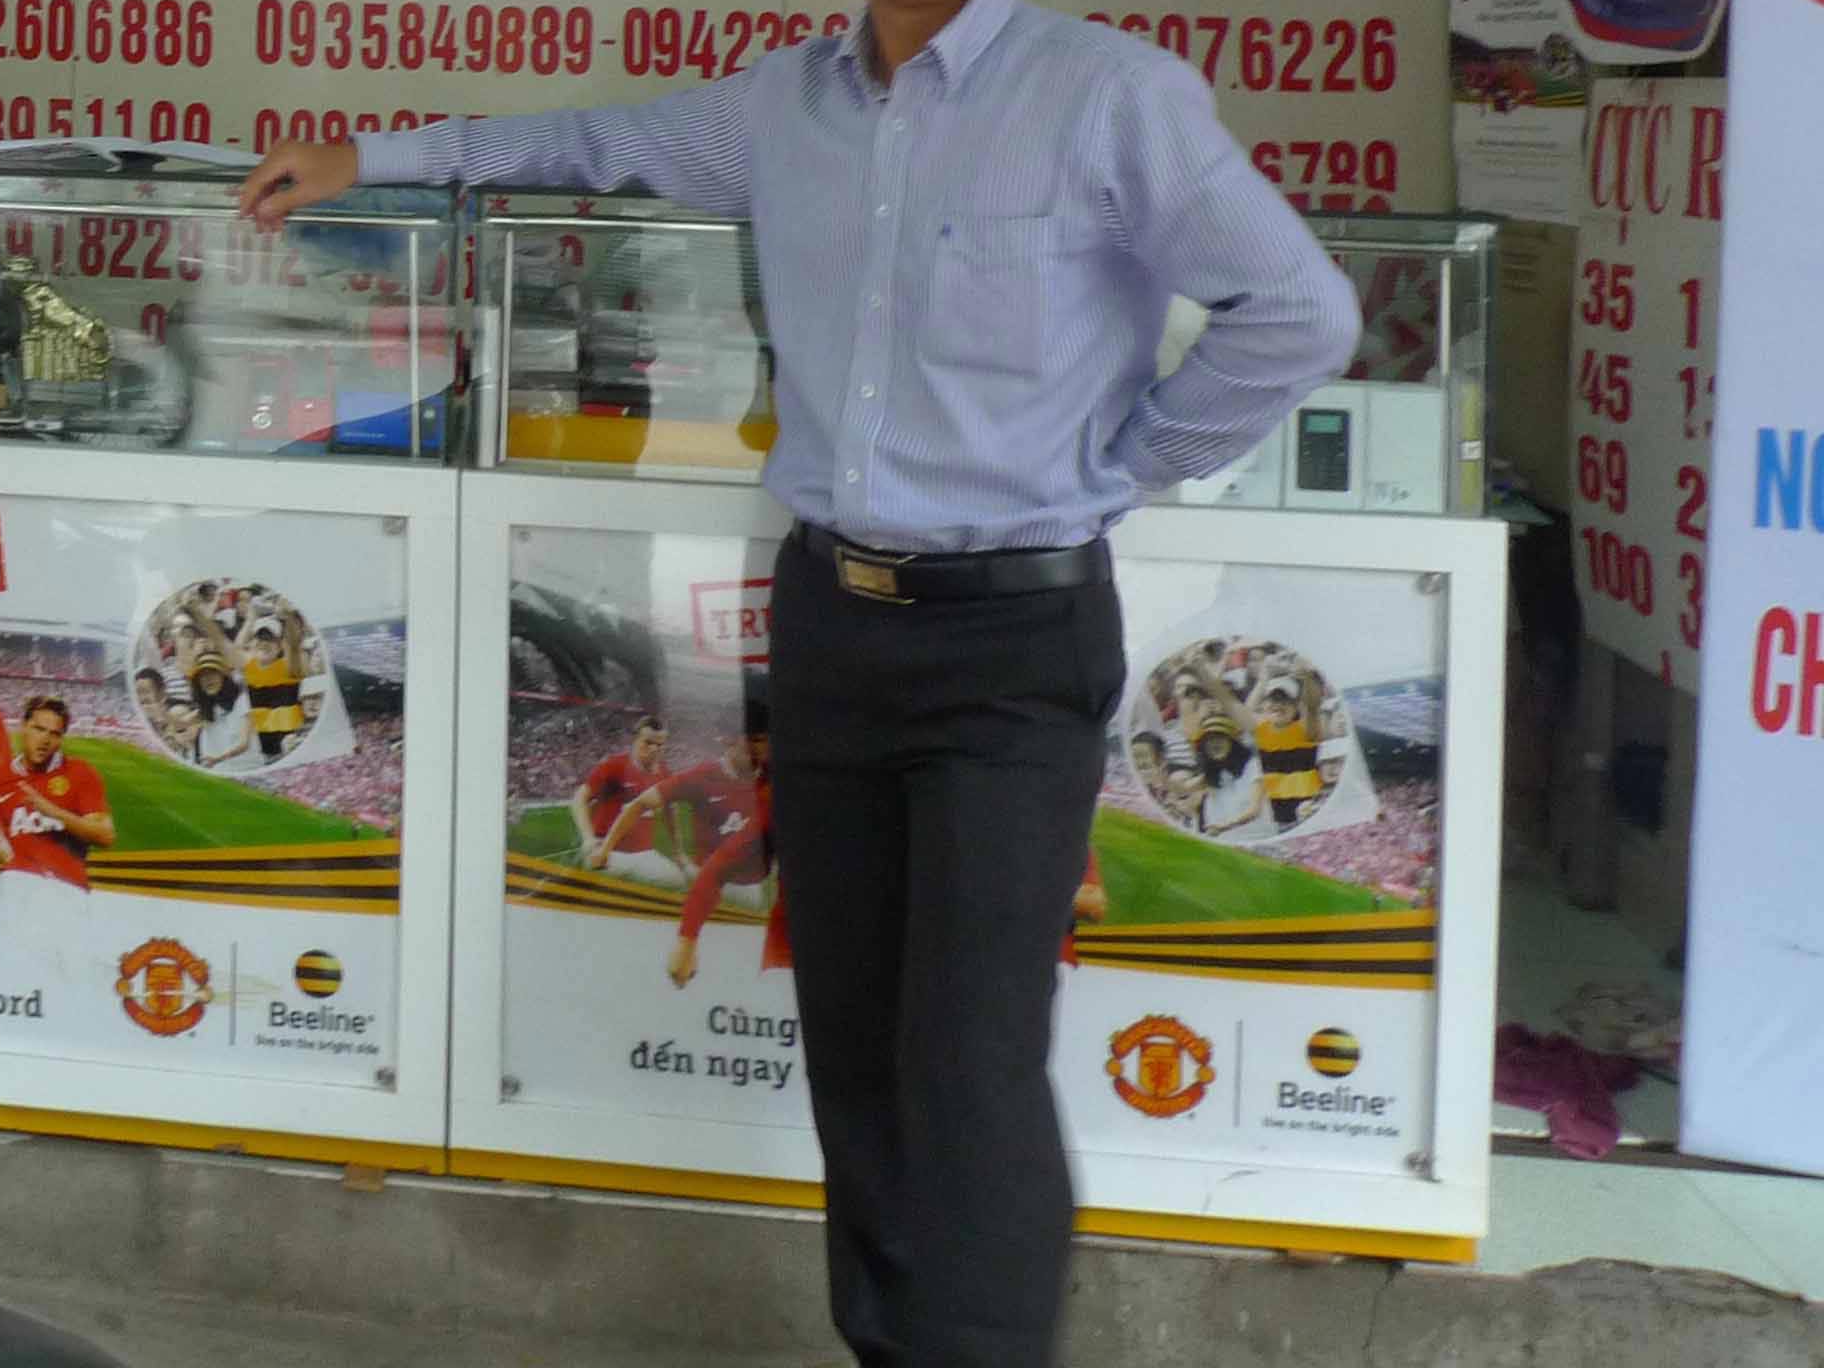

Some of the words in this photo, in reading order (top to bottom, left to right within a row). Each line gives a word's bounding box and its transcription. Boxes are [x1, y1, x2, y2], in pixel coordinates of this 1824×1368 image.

[1580, 258, 1636, 333] 35
[1581, 349, 1633, 424] 45
[1578, 434, 1629, 516] 69
[268, 1001, 366, 1034] Beeline
[708, 1005, 799, 1047] Cùng
[630, 1040, 695, 1075] đến
[706, 1050, 793, 1089] ngay
[1277, 1080, 1386, 1116] Beeline
